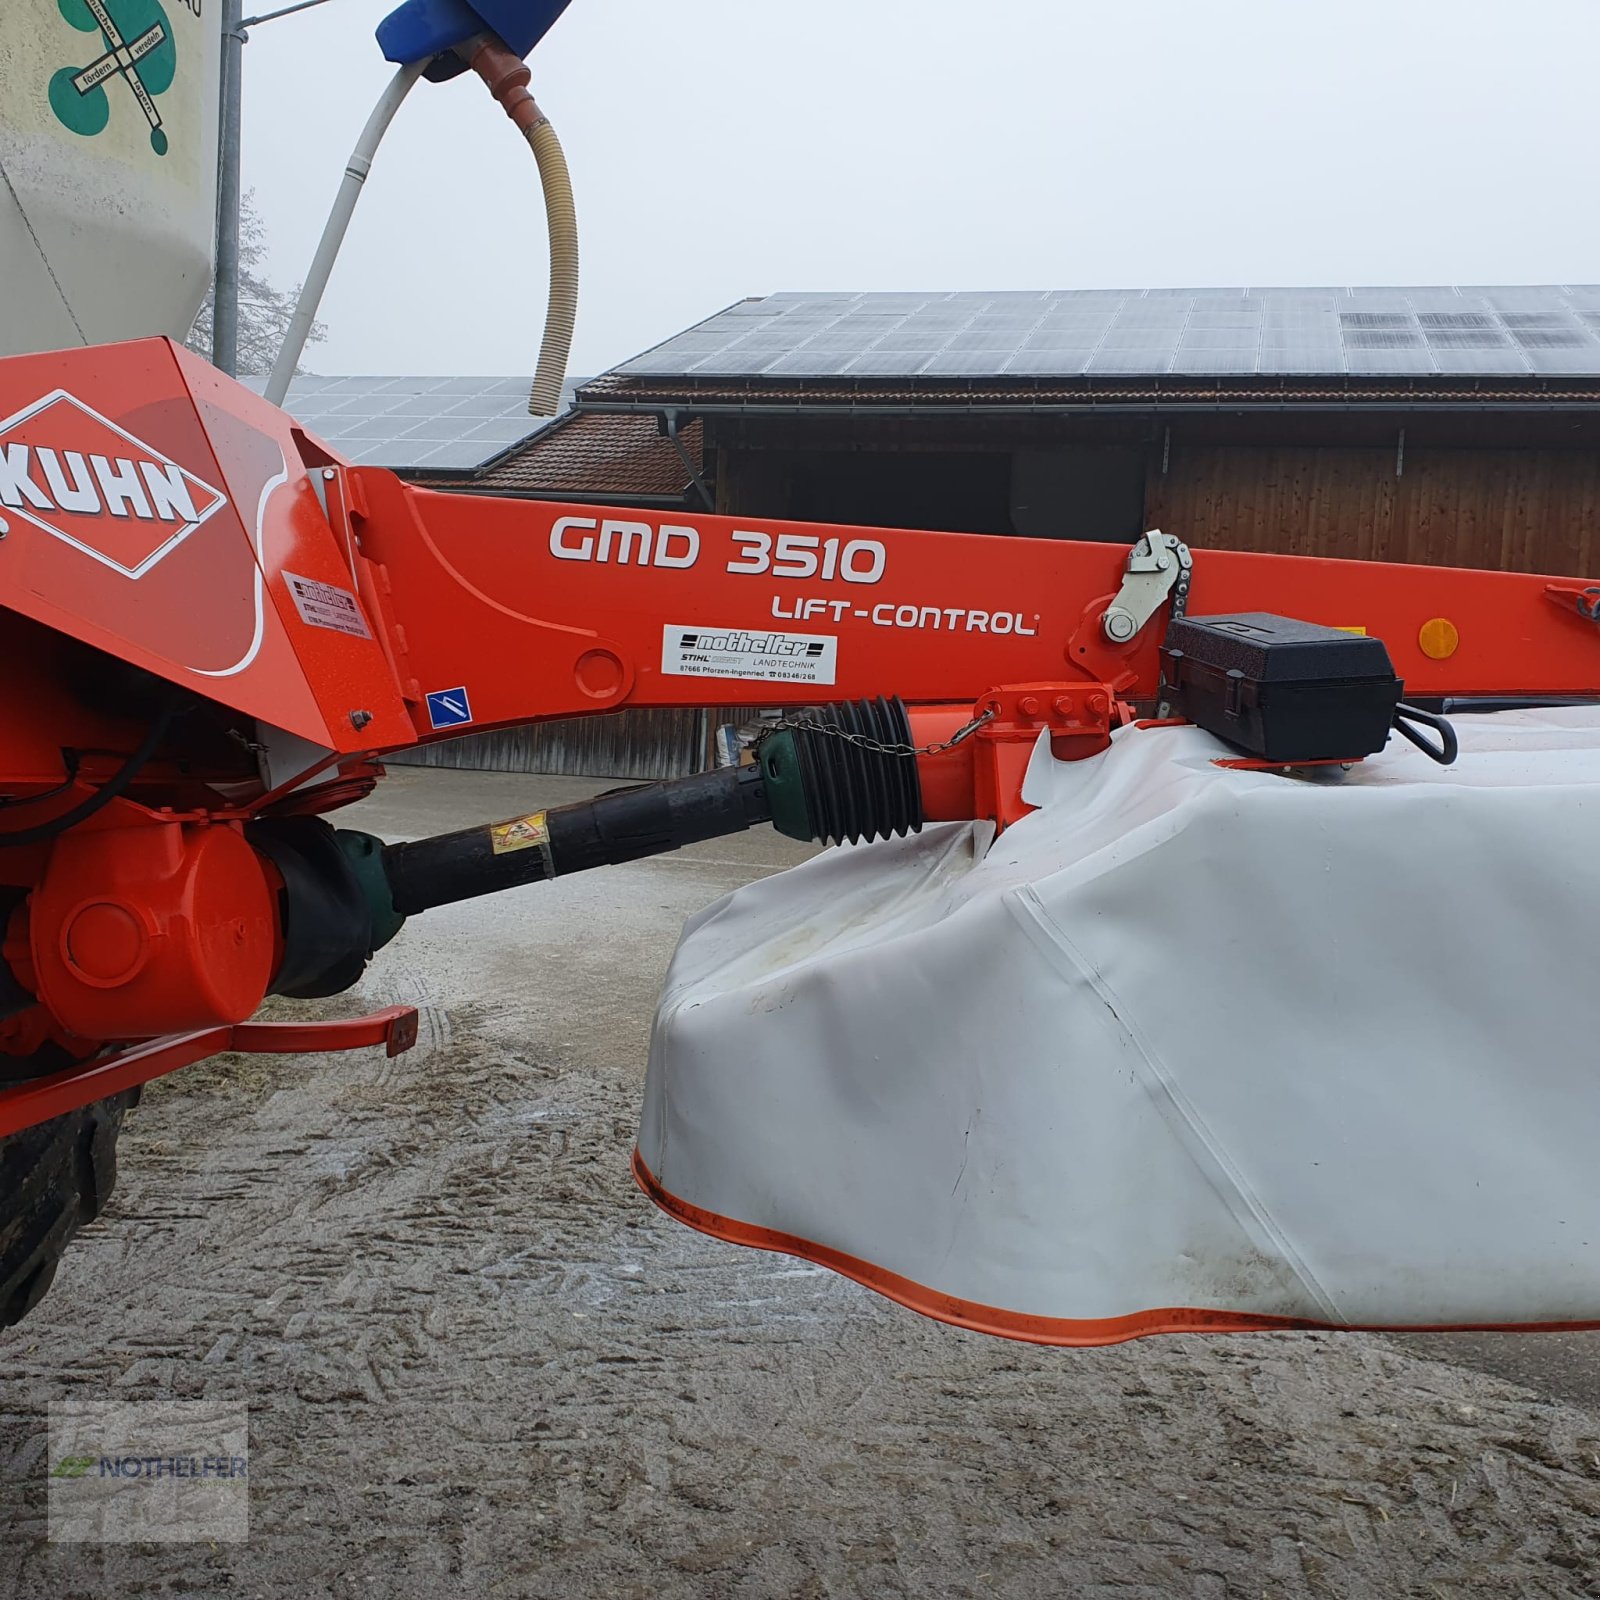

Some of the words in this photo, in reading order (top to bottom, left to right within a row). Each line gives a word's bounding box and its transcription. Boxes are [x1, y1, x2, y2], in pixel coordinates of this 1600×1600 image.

[134, 31, 161, 55] veredeln
[83, 61, 112, 86] fördern
[134, 80, 152, 114] lagern
[0, 442, 200, 523] KUHN
[549, 516, 701, 570] GMD
[726, 530, 886, 584] 3510
[771, 595, 1037, 636] LIFT-CONTROL
[697, 632, 808, 657] nothelfer
[681, 653, 711, 663] STIHL
[753, 659, 816, 670] LANDTECHNIK
[703, 667, 765, 677] Pforzen-Ingenried
